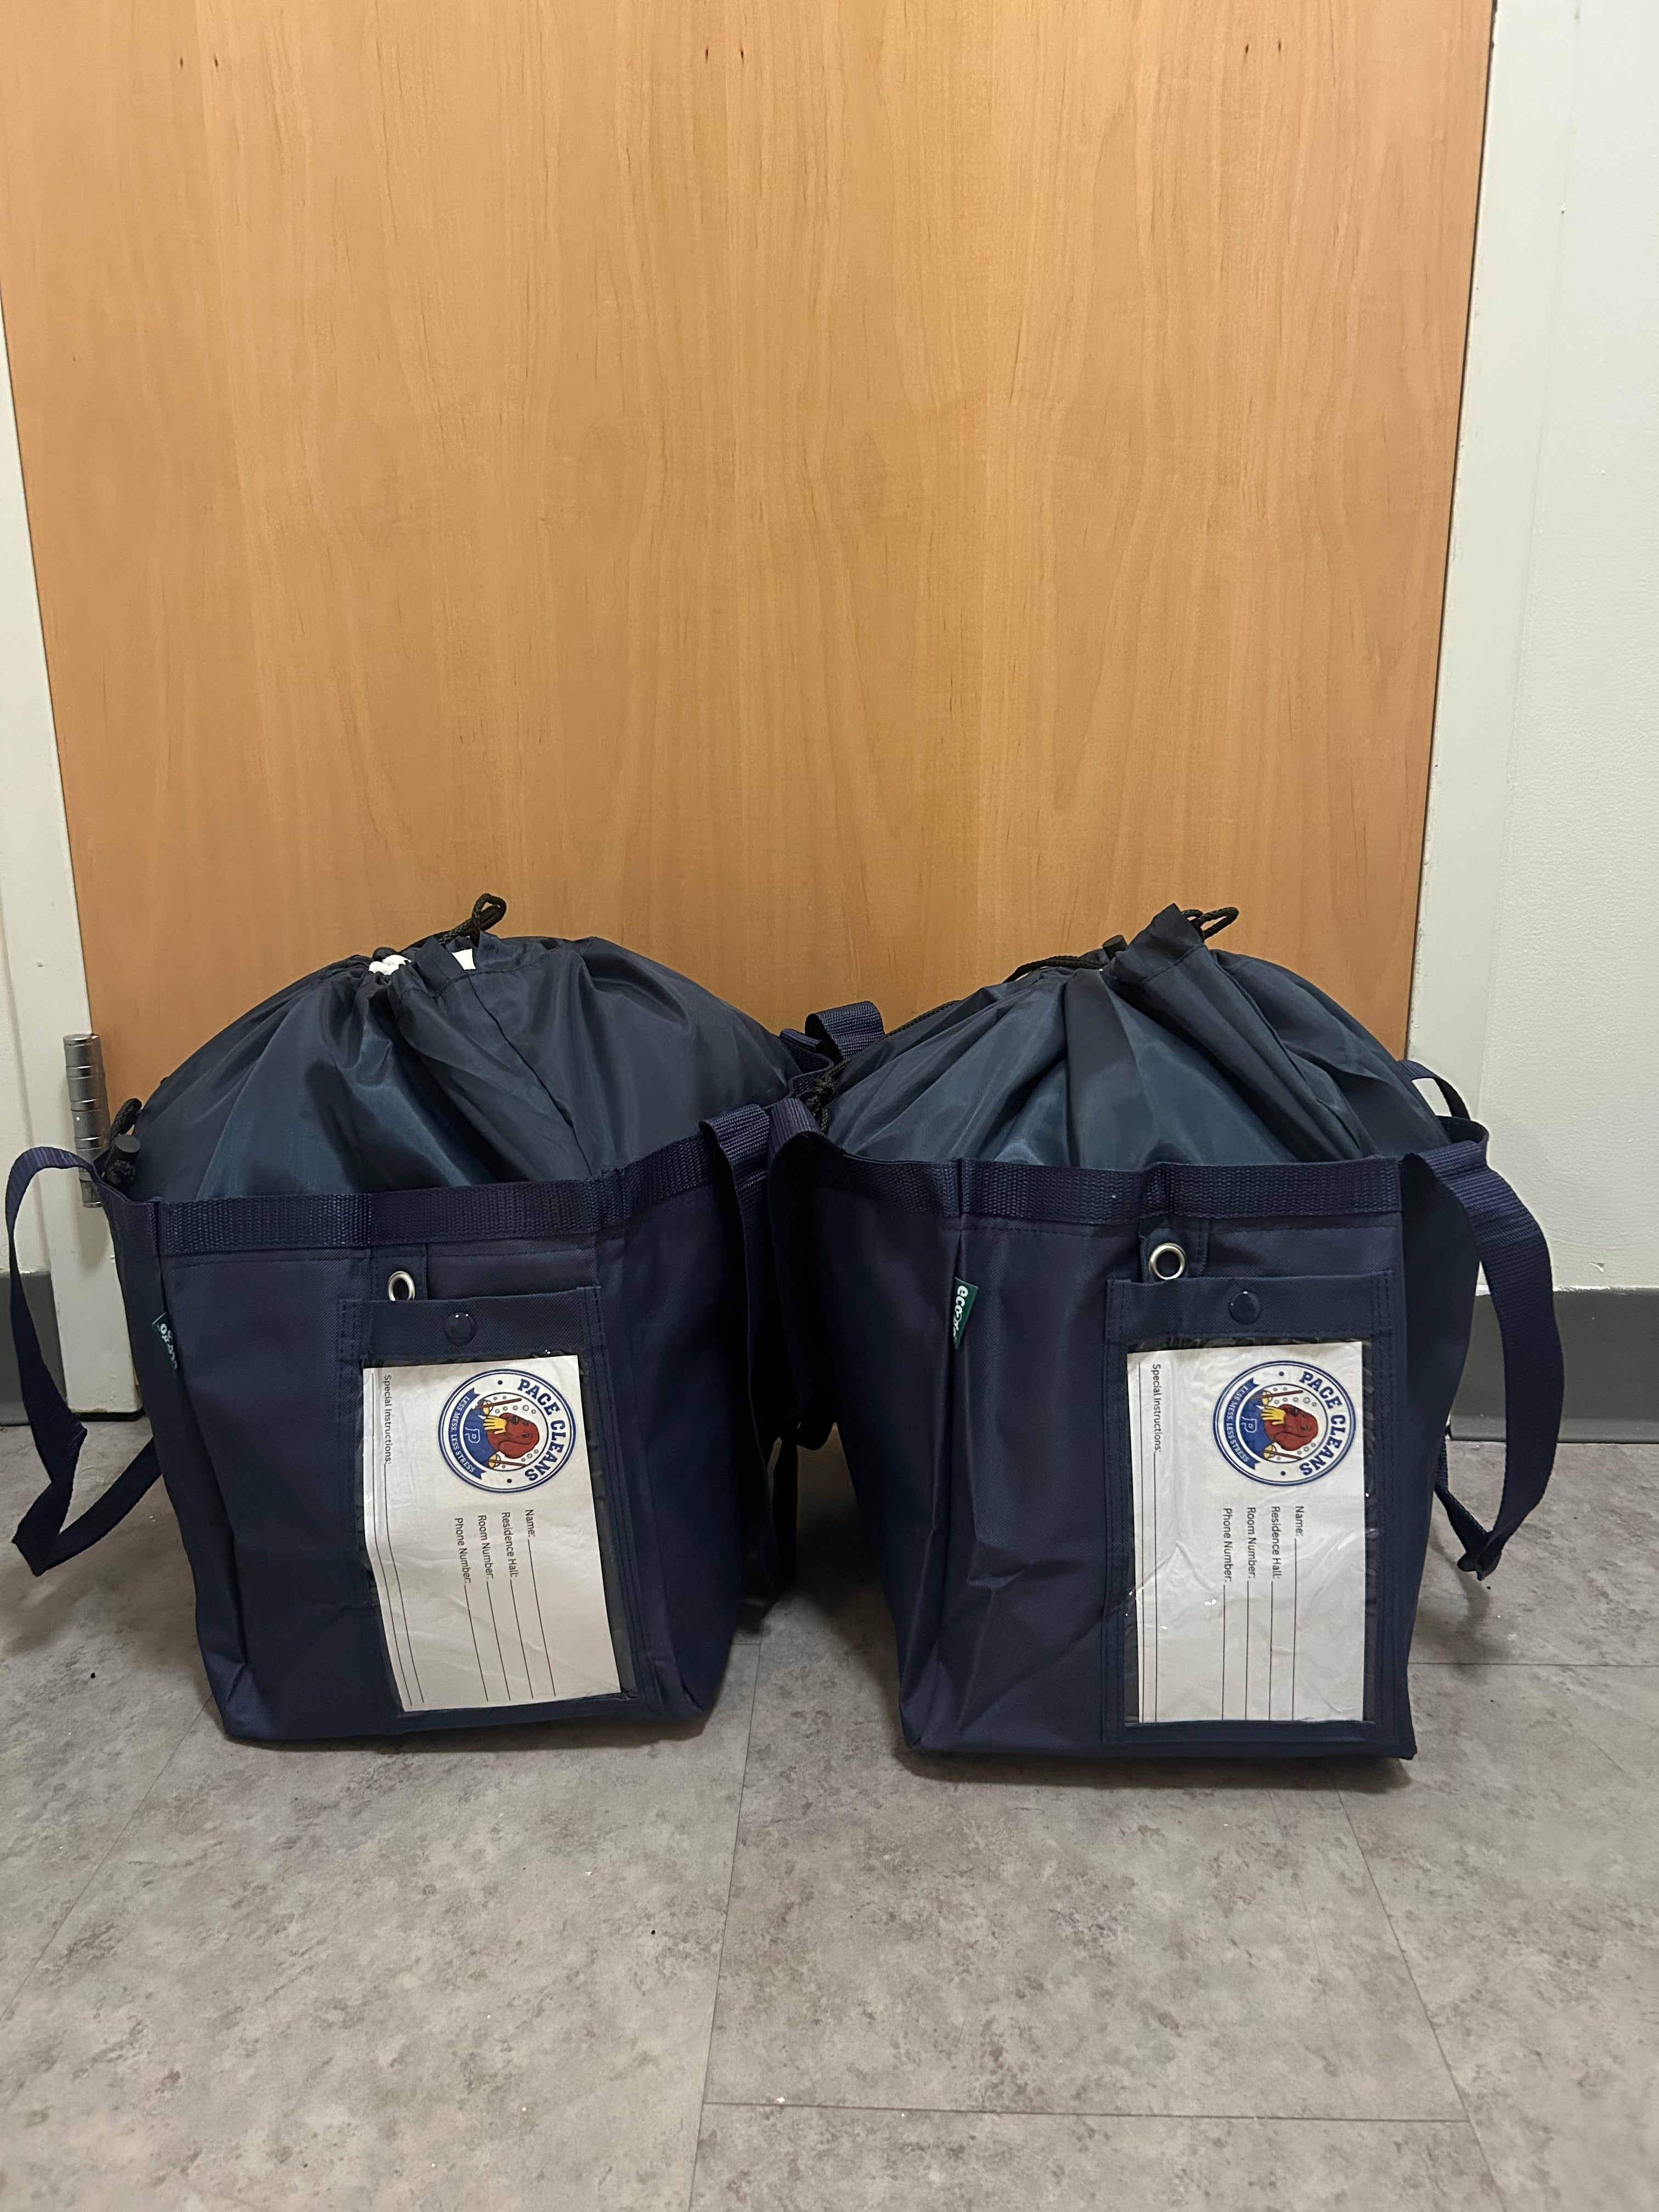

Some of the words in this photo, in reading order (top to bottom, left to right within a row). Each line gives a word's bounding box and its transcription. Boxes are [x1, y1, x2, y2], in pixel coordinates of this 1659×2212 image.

[383, 1374, 392, 1407] Special
[1152, 1364, 1161, 1396] Special
[1234, 1385, 1249, 1401] LESS
[1299, 1371, 1342, 1409] PACE
[457, 1396, 470, 1412] LESS
[518, 1378, 560, 1416] PACE
[384, 1408, 392, 1464] Instructions:
[451, 1434, 460, 1450] LESS
[1153, 1398, 1164, 1454] Instructions:
[524, 1420, 567, 1481] CLEANS
[1231, 1438, 1250, 1463] STRESS
[1299, 1414, 1346, 1476] CLEANS
[455, 1450, 476, 1473] STRESS
[454, 1517, 465, 1545] Phone
[477, 1514, 488, 1541] Room
[525, 1509, 536, 1538] Name:
[1223, 1508, 1233, 1538] Phone
[1247, 1507, 1256, 1537] Room
[1271, 1506, 1281, 1556] Residence
[1295, 1505, 1304, 1537] Name:
[501, 1511, 514, 1556] Residence
[509, 1558, 518, 1578] Hall:
[1248, 1538, 1256, 1579] Number:
[459, 1548, 471, 1583] Number:
[482, 1543, 494, 1579] Number:
[1223, 1542, 1233, 1583] Number:
[1272, 1558, 1282, 1579] Hall:
